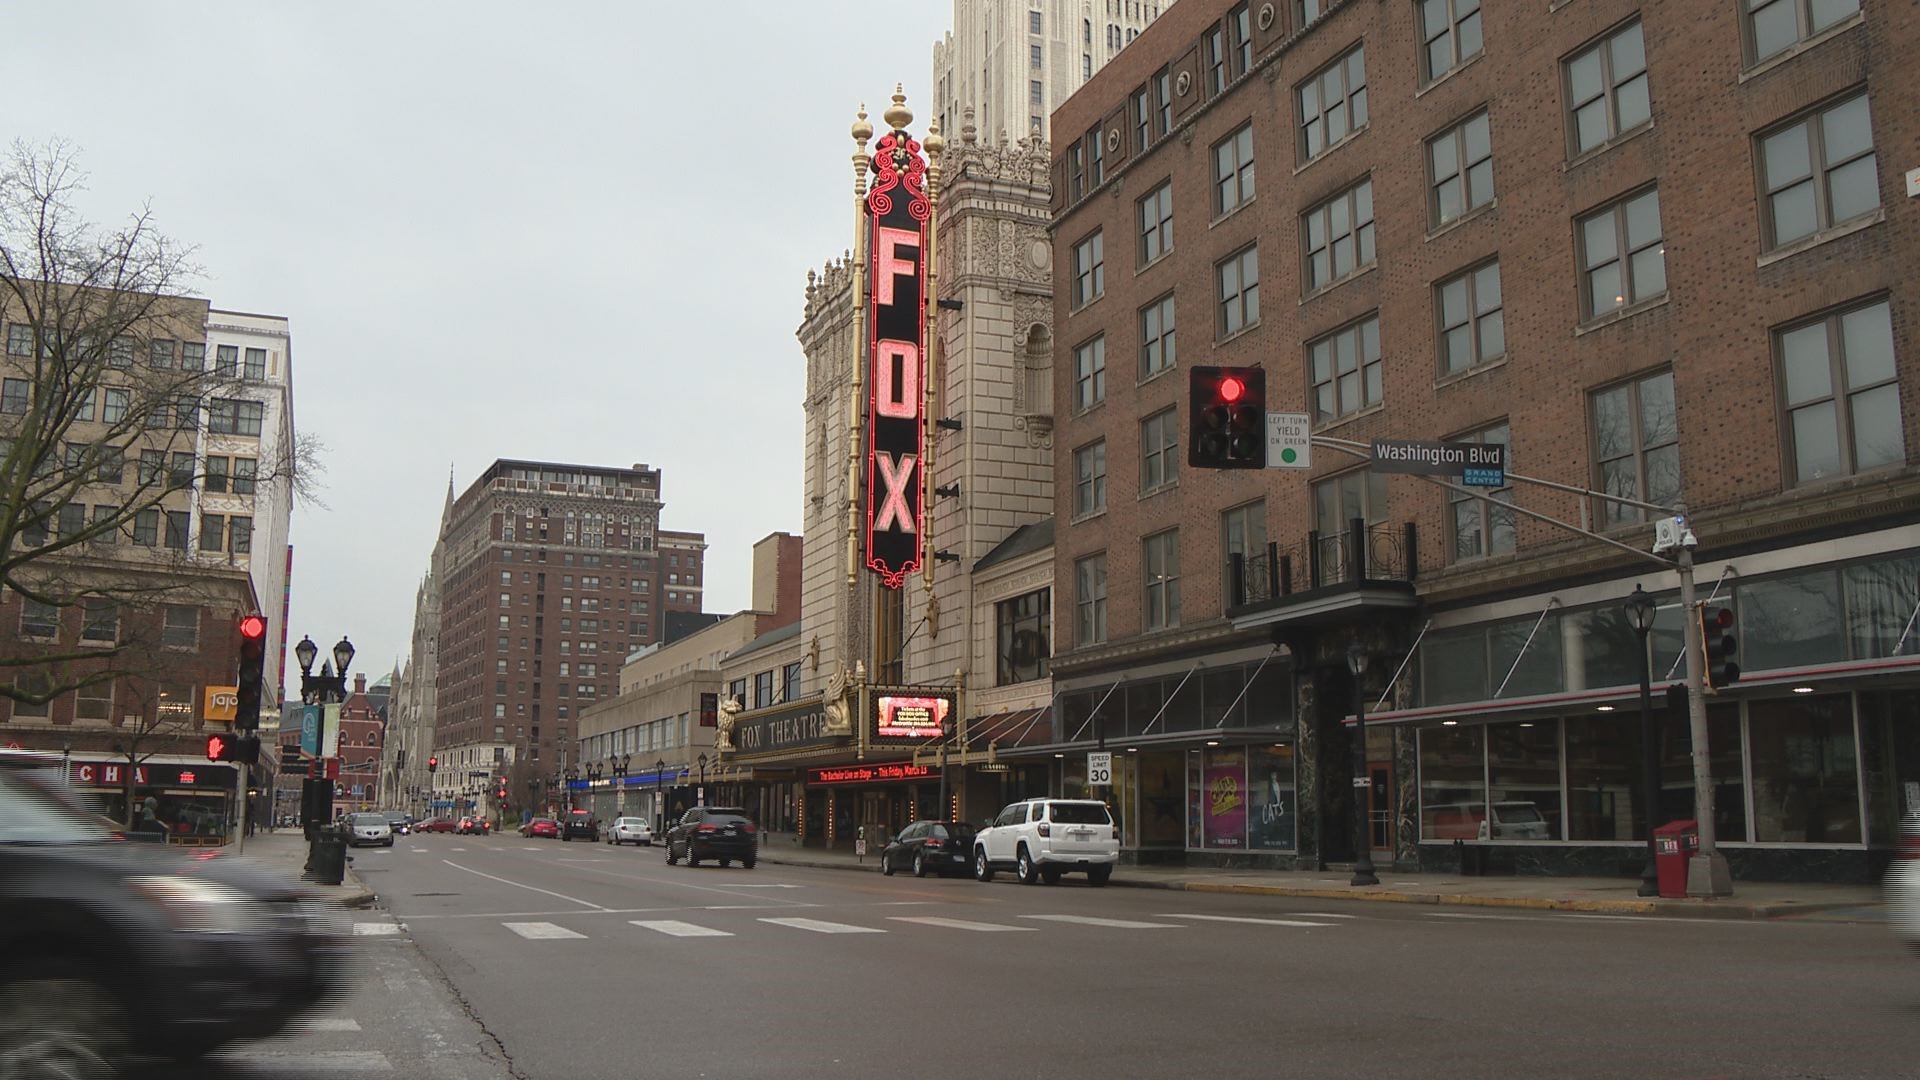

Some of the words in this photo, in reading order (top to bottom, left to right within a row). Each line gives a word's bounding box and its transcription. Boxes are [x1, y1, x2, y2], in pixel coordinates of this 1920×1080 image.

[873, 226, 920, 532] FOX
[1268, 416, 1285, 424] LEFT
[1290, 417, 1308, 425] TURN
[1277, 426, 1300, 436] YIELD
[1285, 438, 1307, 446] GREEN
[1376, 443, 1464, 466] Washington
[1469, 447, 1500, 464] Blvd
[1464, 469, 1501, 477] GRAND
[1465, 476, 1501, 485] CENTER
[741, 724, 761, 749] FOX
[820, 771, 828, 781] The
[844, 769, 853, 780] Live
[860, 768, 872, 781] Stage
[879, 766, 888, 777] This
[1091, 769, 1109, 782] 30
[1262, 800, 1284, 825] CATS
